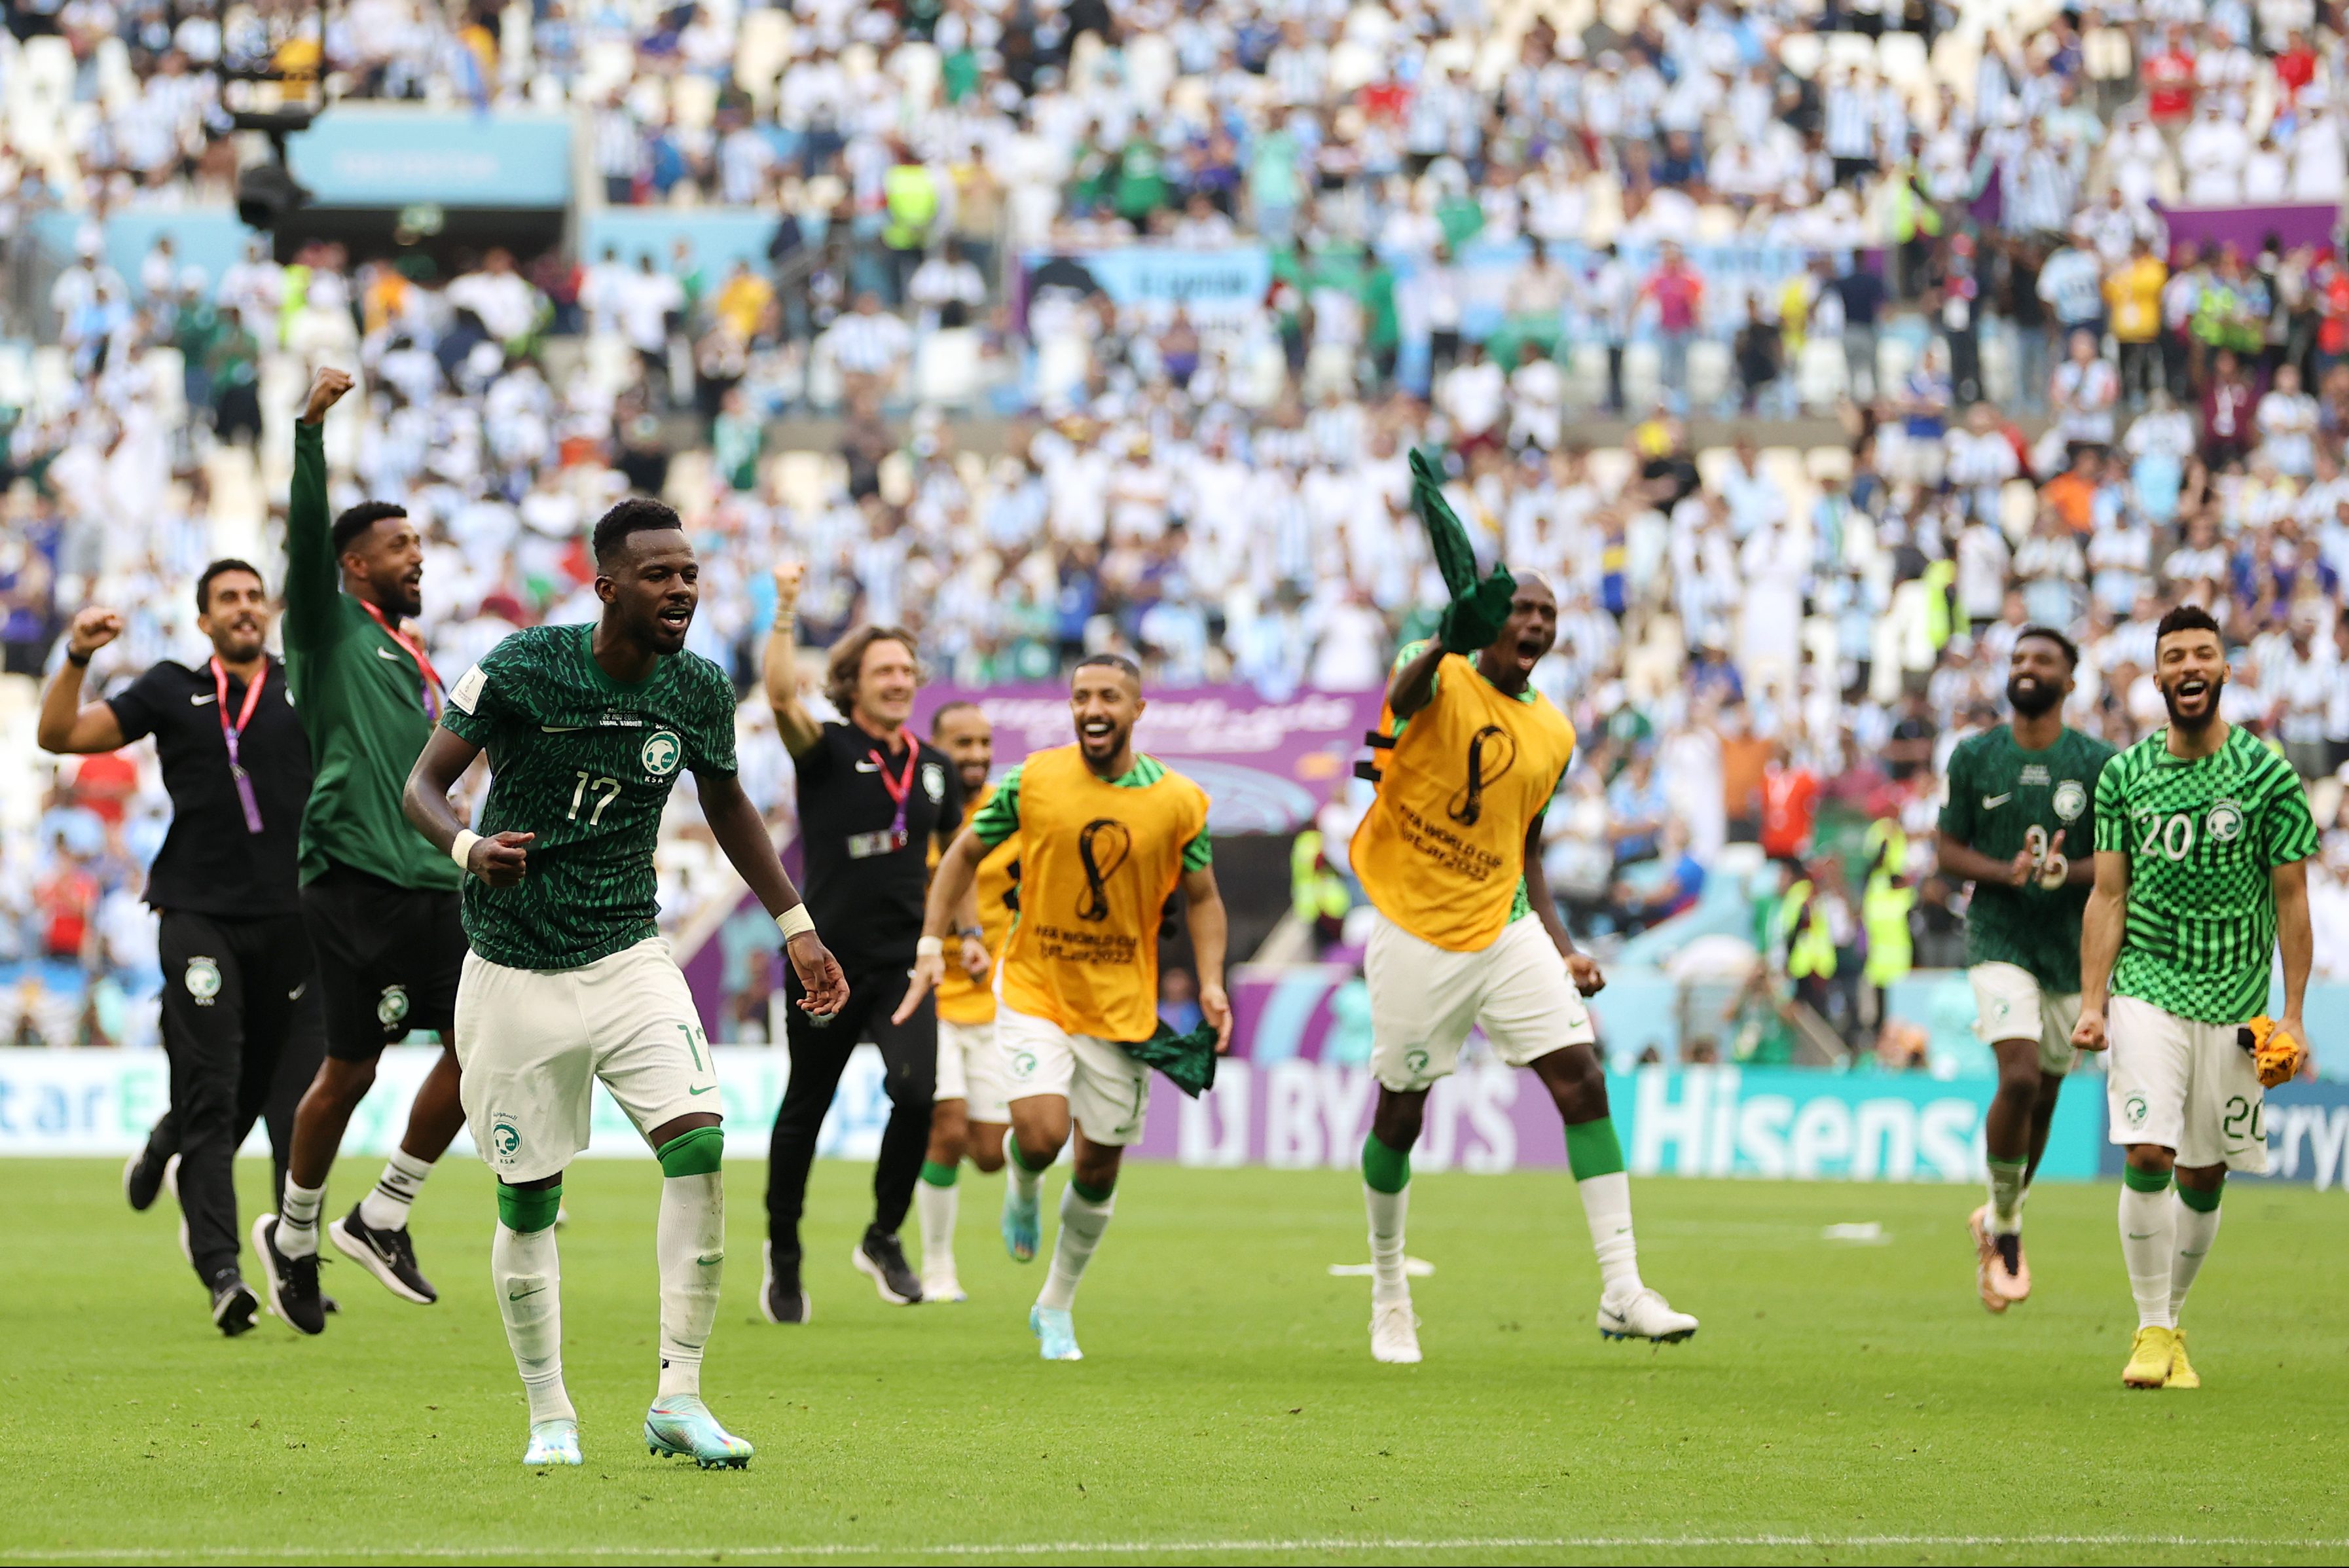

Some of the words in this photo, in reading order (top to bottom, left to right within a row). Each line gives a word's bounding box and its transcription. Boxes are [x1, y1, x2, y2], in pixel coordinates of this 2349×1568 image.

[568, 771, 622, 826] 17
[1424, 822, 1476, 856] WORLD
[1477, 850, 1502, 869] CUP
[2140, 812, 2193, 862] 20
[1630, 1063, 1988, 1182] Hisens
